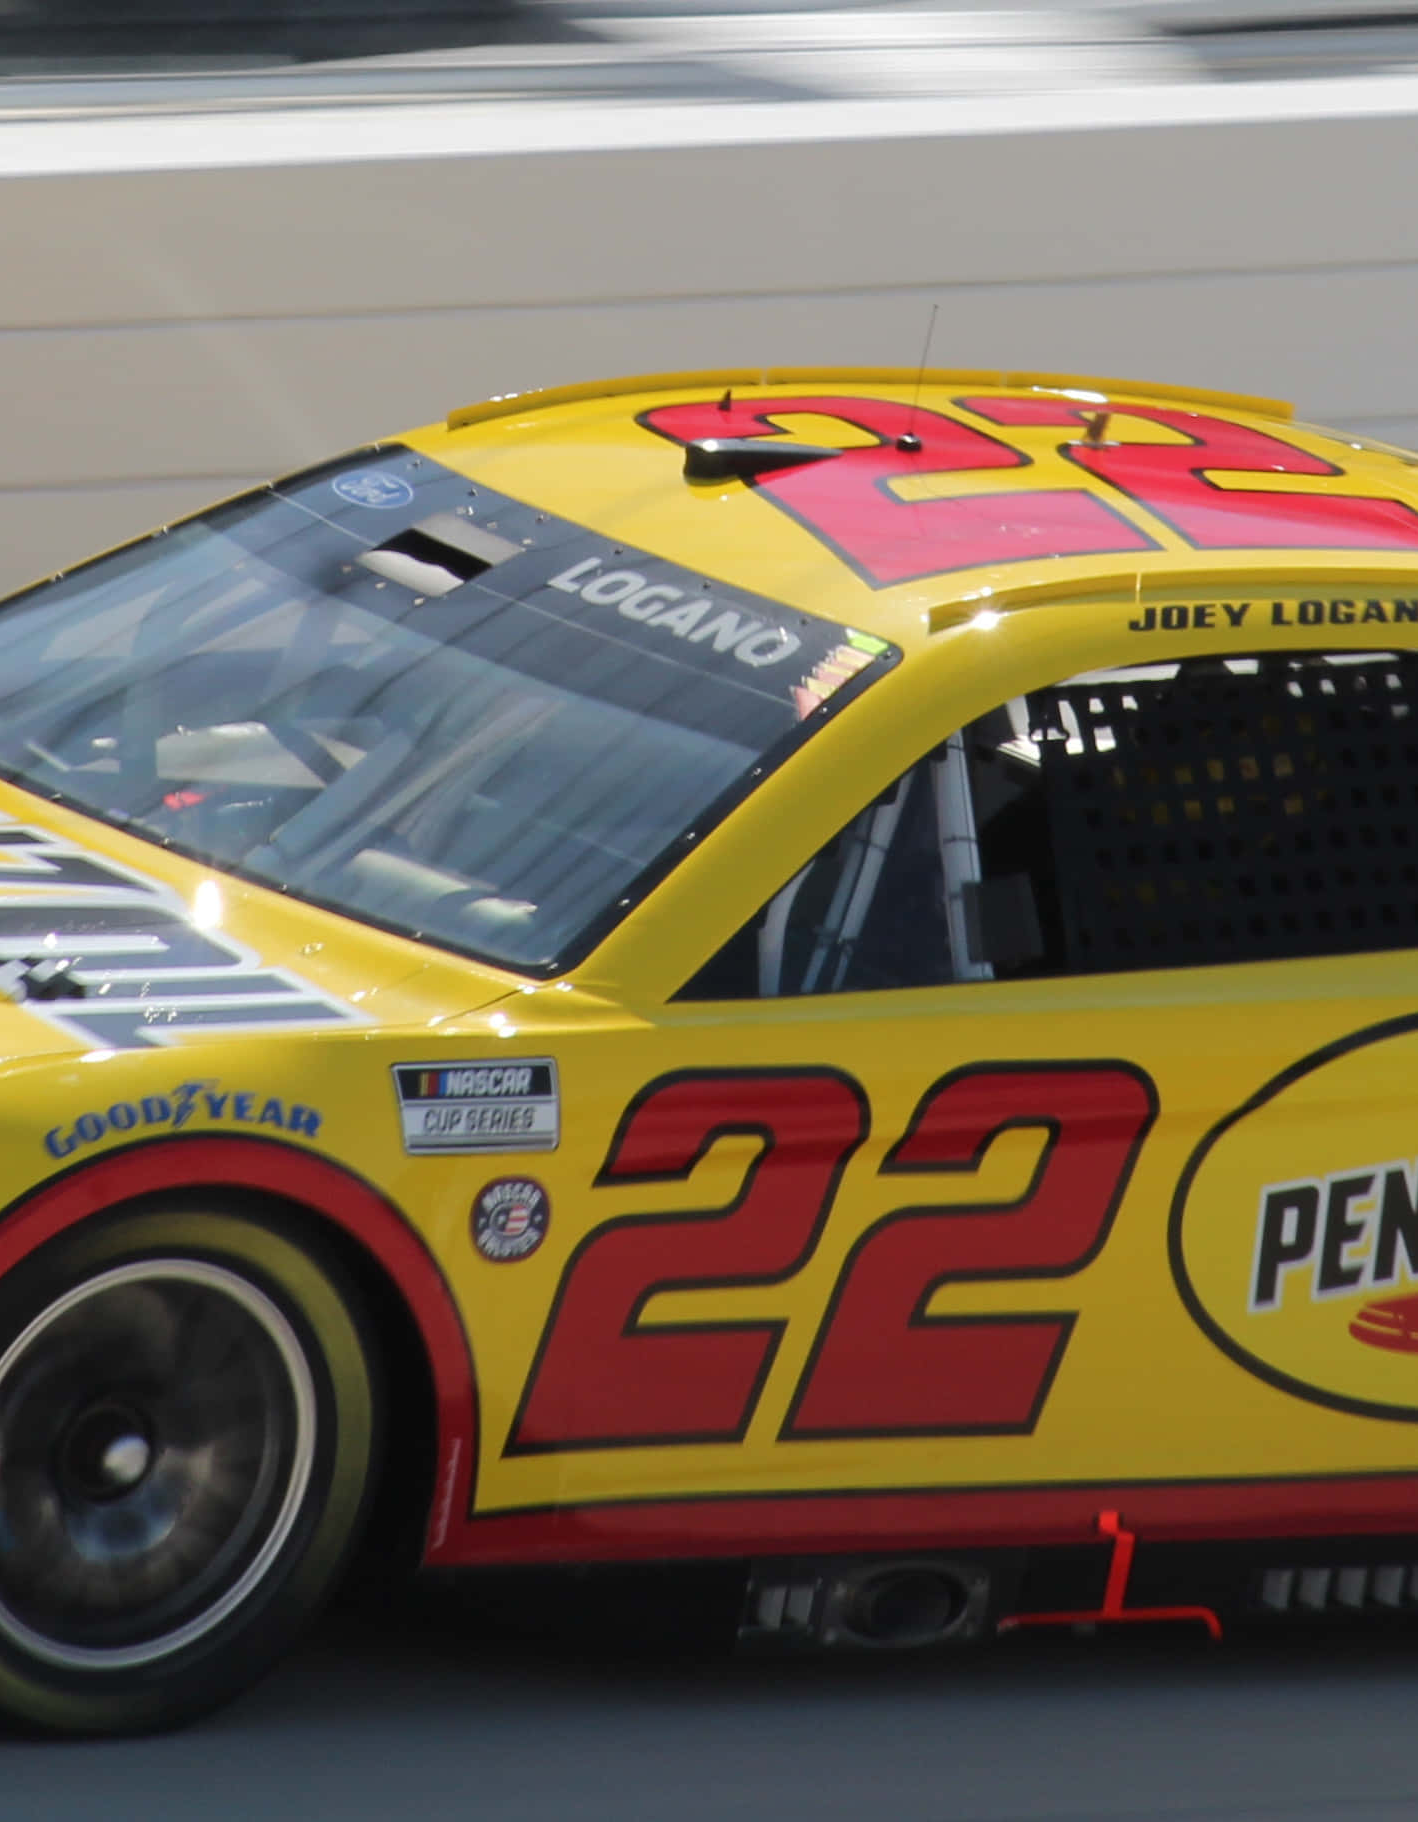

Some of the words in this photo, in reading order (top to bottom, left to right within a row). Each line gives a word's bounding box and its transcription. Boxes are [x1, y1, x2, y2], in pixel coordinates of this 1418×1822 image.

[546, 557, 802, 668] LOGANO
[1128, 602, 1252, 632] JOEY
[445, 1066, 533, 1097] NASCAR
[423, 1107, 462, 1133] CUP
[465, 1106, 535, 1133] SERIES
[501, 1057, 1160, 1458] 22
